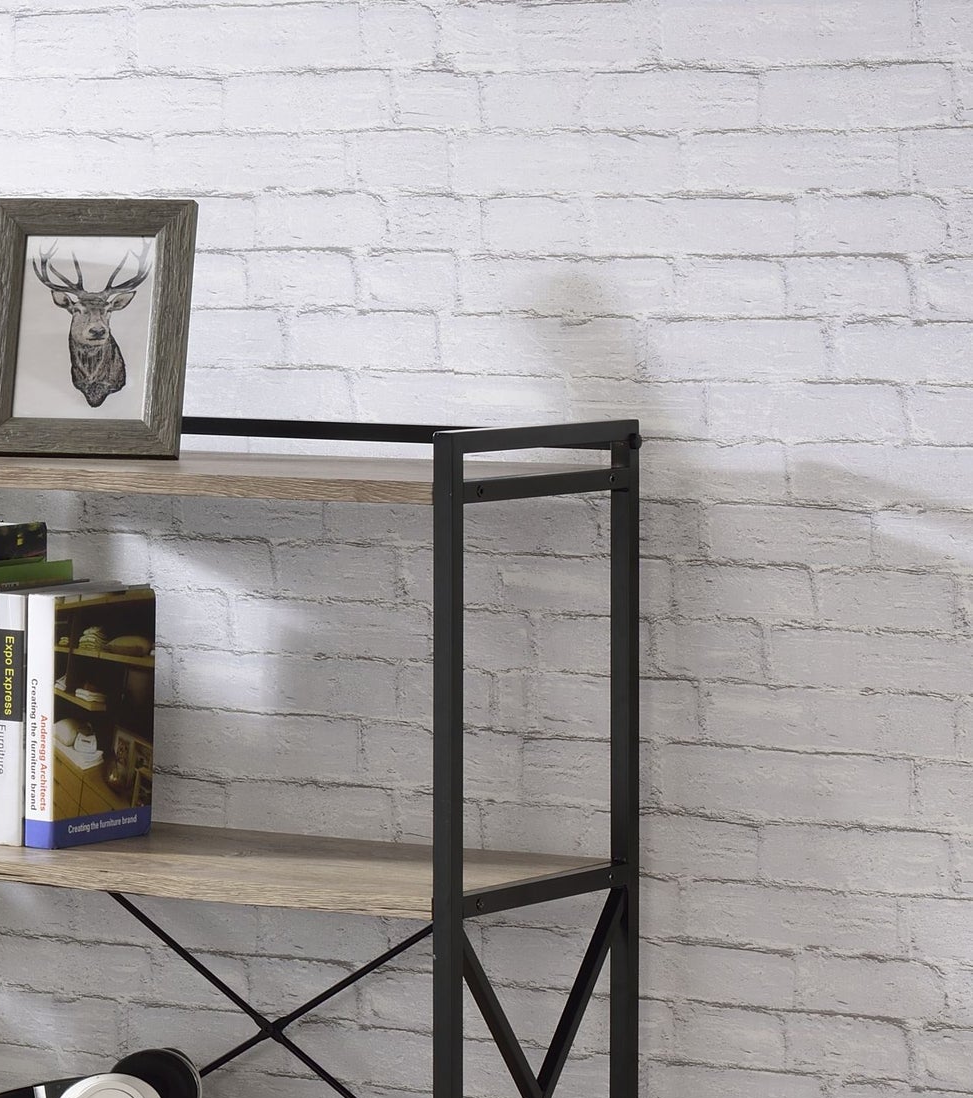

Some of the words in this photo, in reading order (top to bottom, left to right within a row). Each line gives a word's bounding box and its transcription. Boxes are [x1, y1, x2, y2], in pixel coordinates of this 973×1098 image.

[3, 636, 15, 665] Expo
[3, 668, 15, 716] Express
[29, 678, 39, 719] Creating
[30, 722, 38, 737] the
[39, 715, 48, 761] Anderegg
[29, 740, 38, 780] furniture
[29, 783, 38, 811] brand
[39, 763, 48, 811] Architects
[68, 822, 91, 834] Creating
[90, 821, 99, 830] the
[99, 818, 122, 829] furniture
[121, 814, 138, 825] brand
